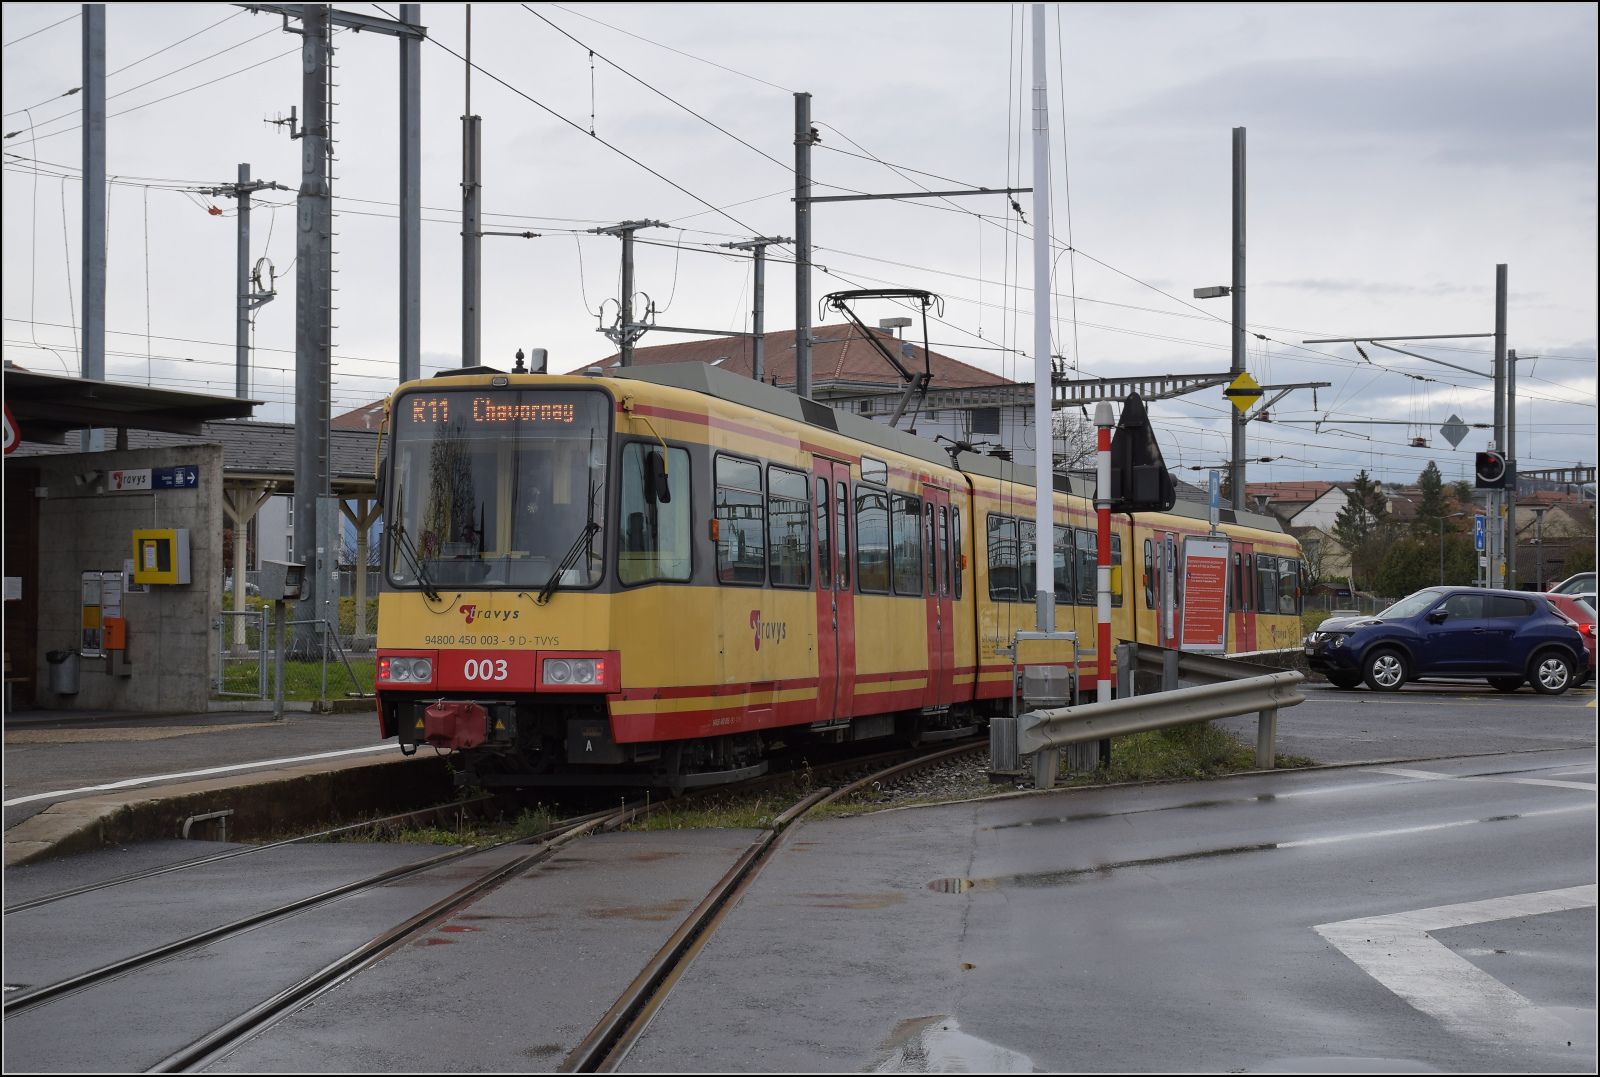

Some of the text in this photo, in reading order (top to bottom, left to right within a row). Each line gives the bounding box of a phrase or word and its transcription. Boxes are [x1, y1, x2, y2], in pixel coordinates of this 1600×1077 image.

[413, 397, 574, 423] R11 Chavornay
[465, 606, 519, 622] travys
[754, 612, 786, 647] travys
[425, 635, 455, 645] 94800
[458, 635, 477, 645] 450
[480, 635, 499, 645] 003
[508, 635, 515, 645] 9
[464, 658, 508, 681] 003
[585, 739, 593, 752] A
